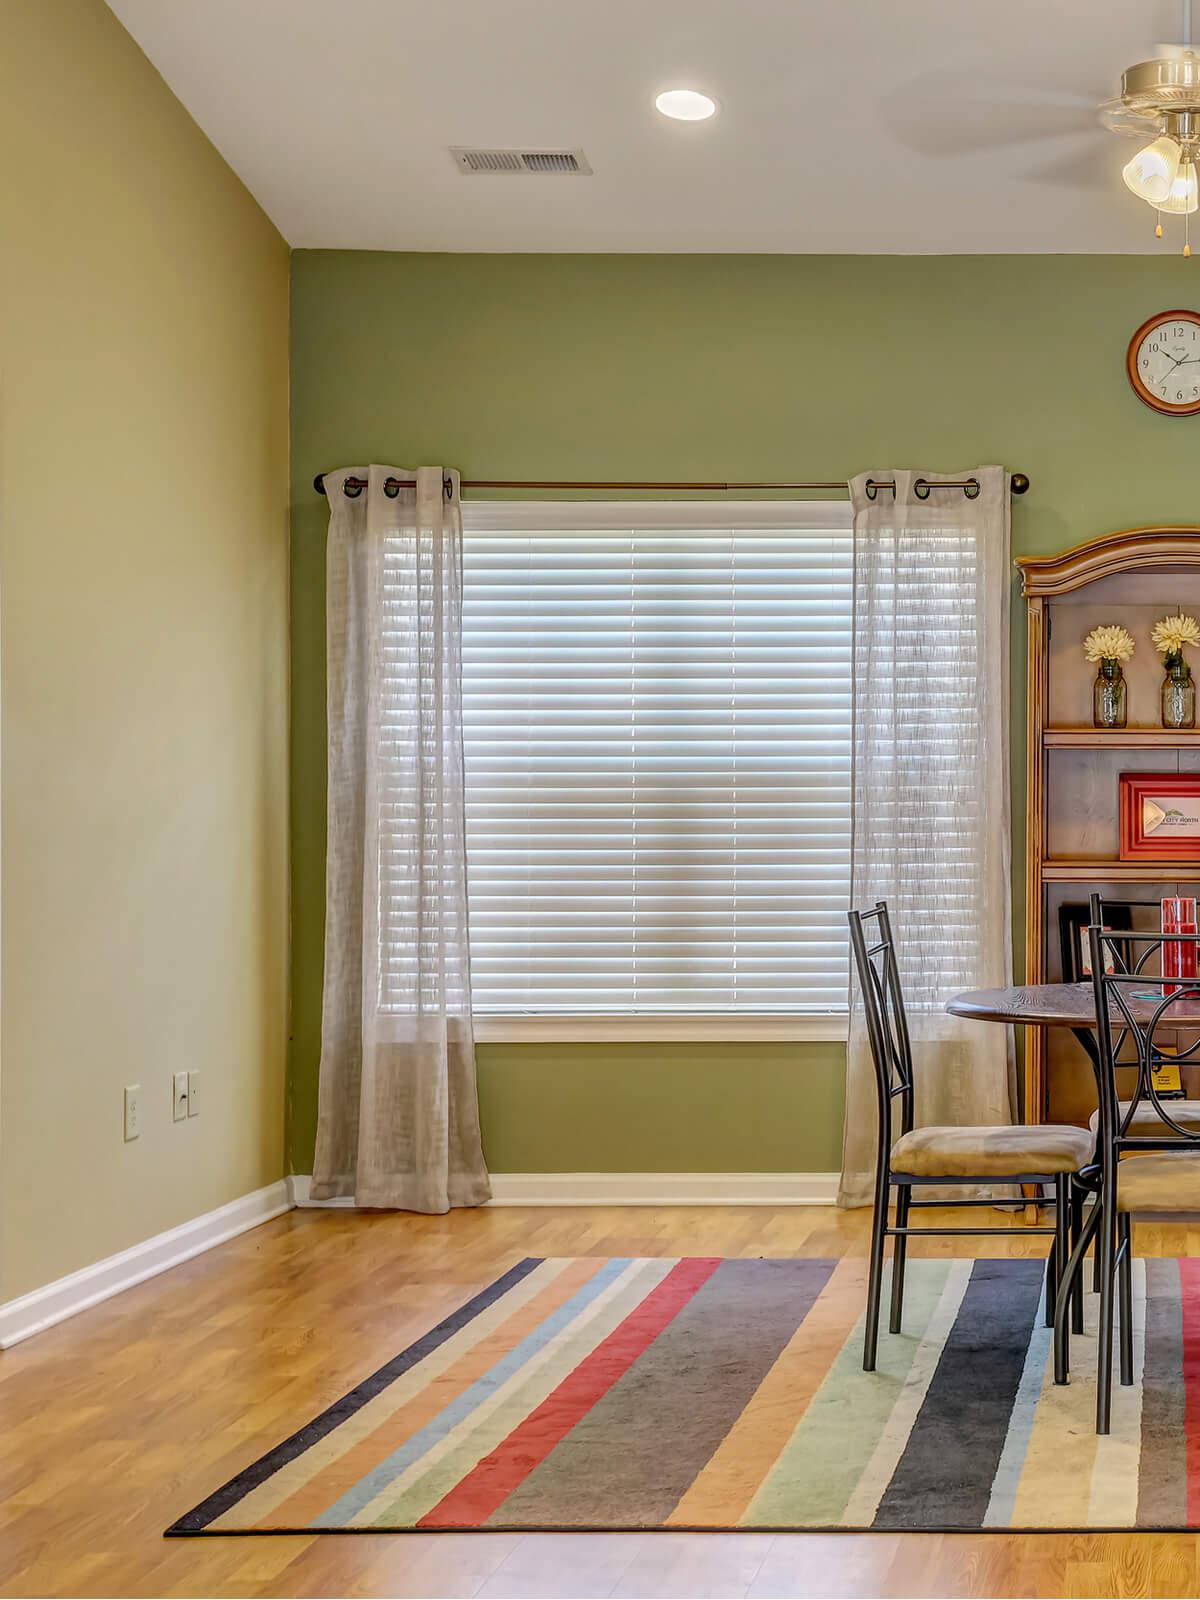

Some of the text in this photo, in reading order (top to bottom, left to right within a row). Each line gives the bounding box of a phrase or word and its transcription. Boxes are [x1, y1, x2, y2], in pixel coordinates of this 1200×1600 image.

[1159, 332, 1167, 341] 11
[1173, 328, 1184, 337] 12
[1148, 343, 1158, 352] 10
[1143, 359, 1149, 368] 9
[1161, 386, 1167, 396] 7
[1176, 390, 1183, 399] 6
[1193, 386, 1198, 396] 5
